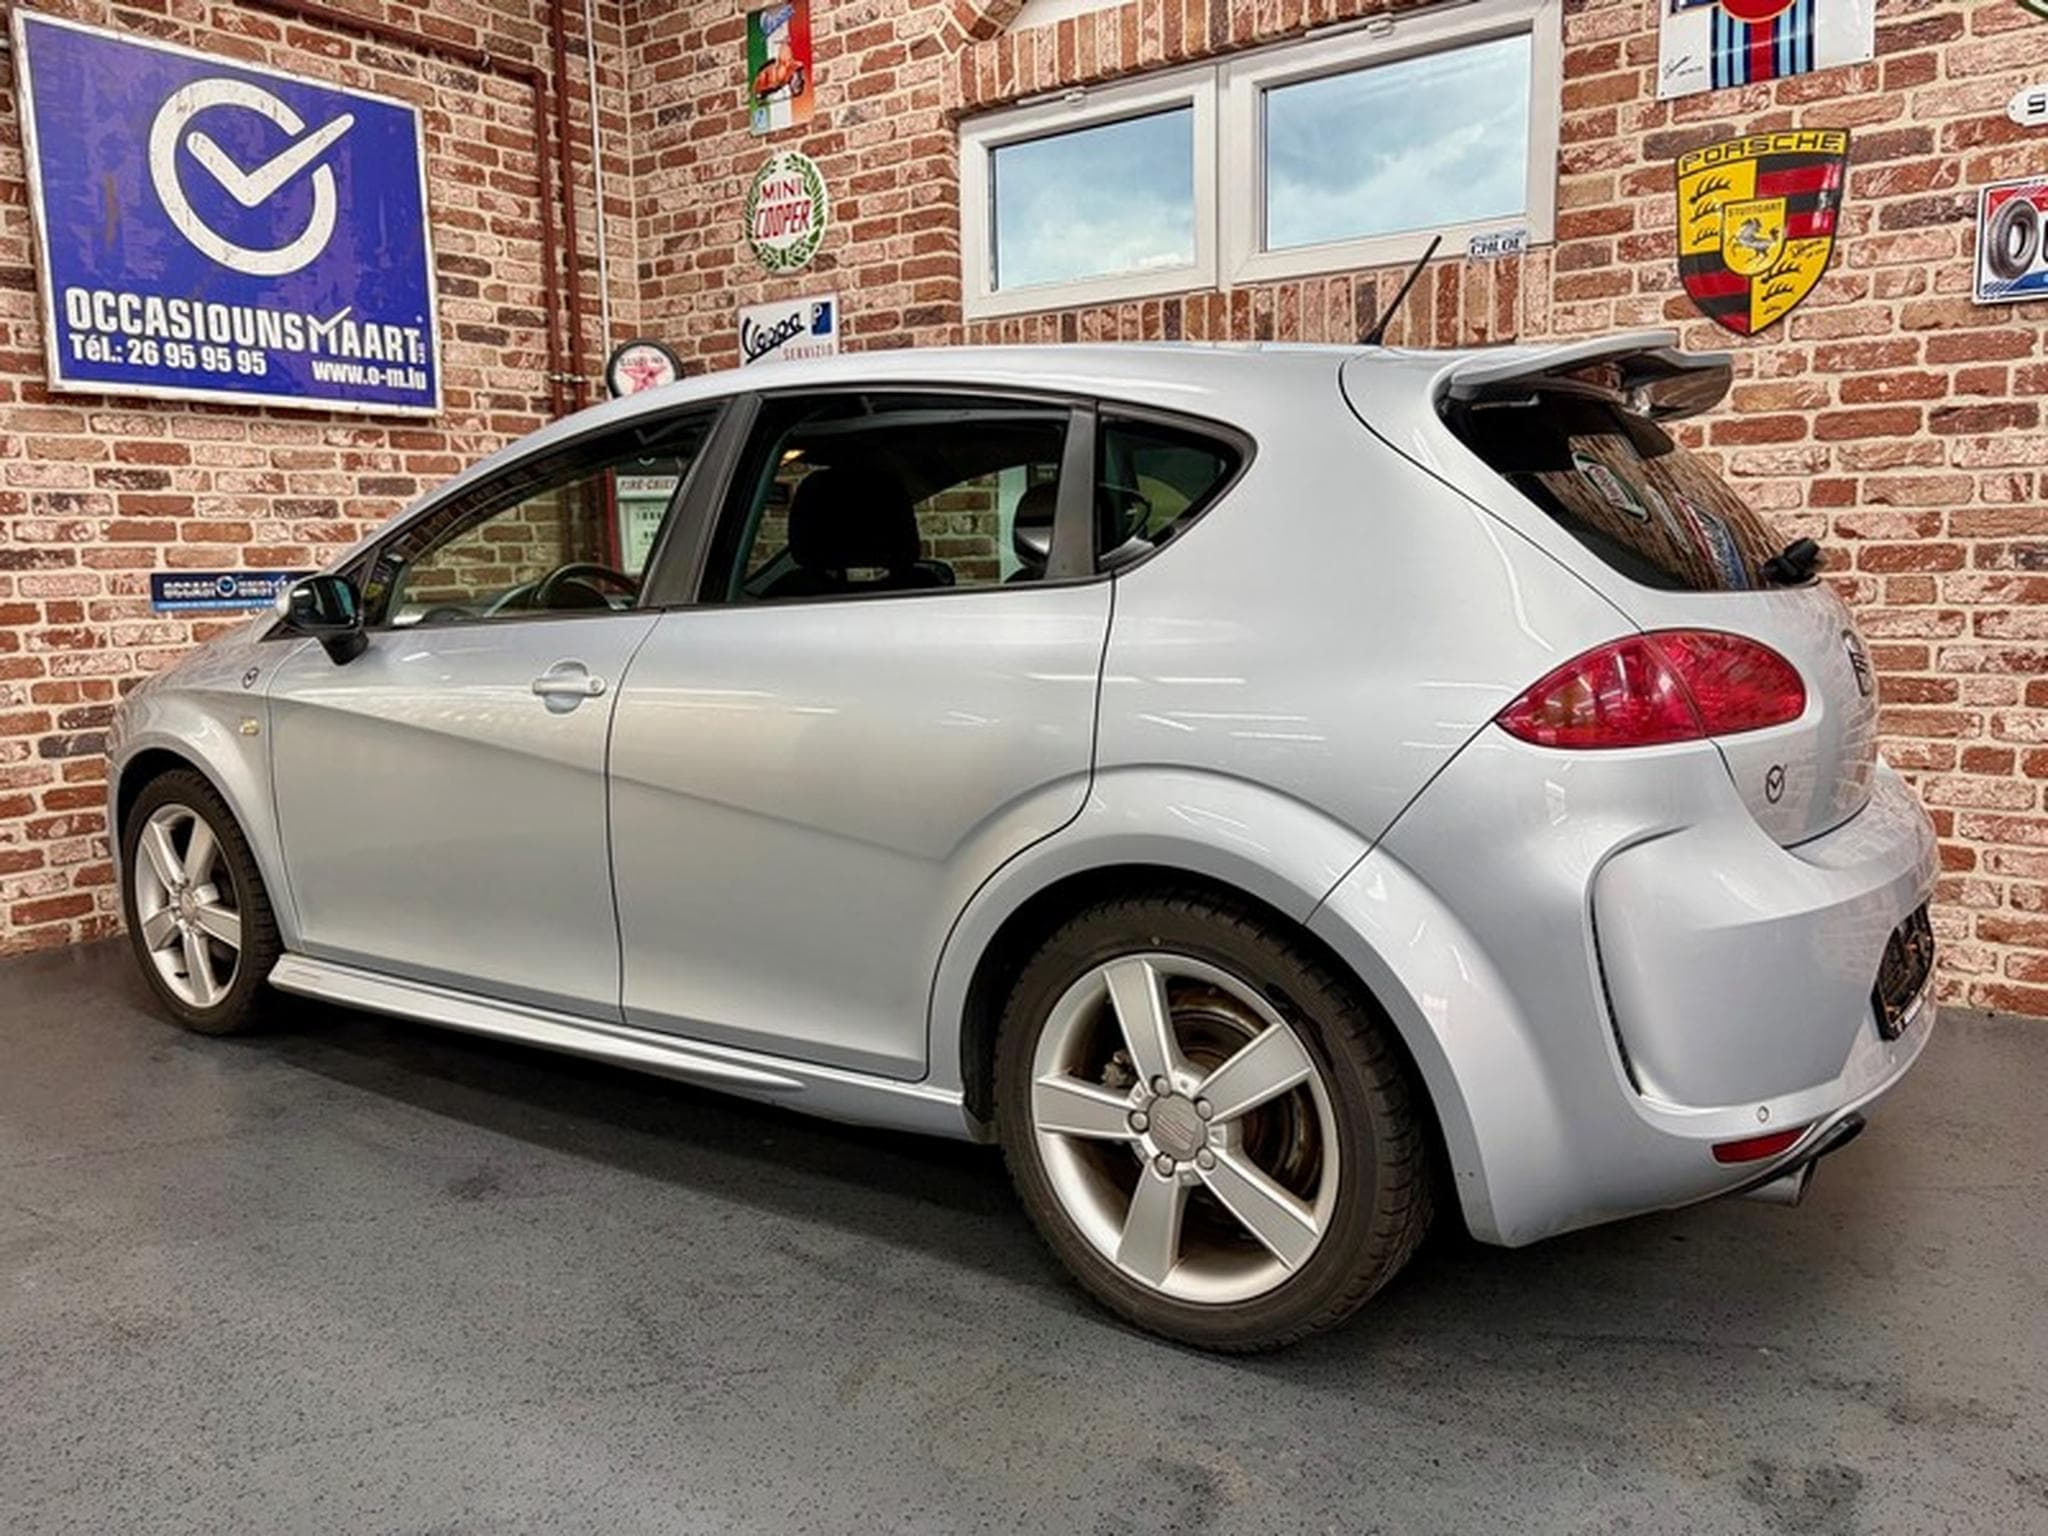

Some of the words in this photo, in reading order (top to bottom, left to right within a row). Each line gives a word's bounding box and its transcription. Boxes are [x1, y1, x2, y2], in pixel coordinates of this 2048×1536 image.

[1682, 133, 1842, 172] PORSCHE
[762, 177, 802, 202] MINI
[755, 200, 811, 240] COOPER
[69, 333, 123, 364] Tél.:
[126, 338, 160, 366] 26
[164, 343, 196, 370] 95
[201, 346, 232, 373] 95
[237, 350, 267, 376] 95
[741, 316, 805, 364] Vespa
[312, 359, 427, 391] www.o-m.lu
